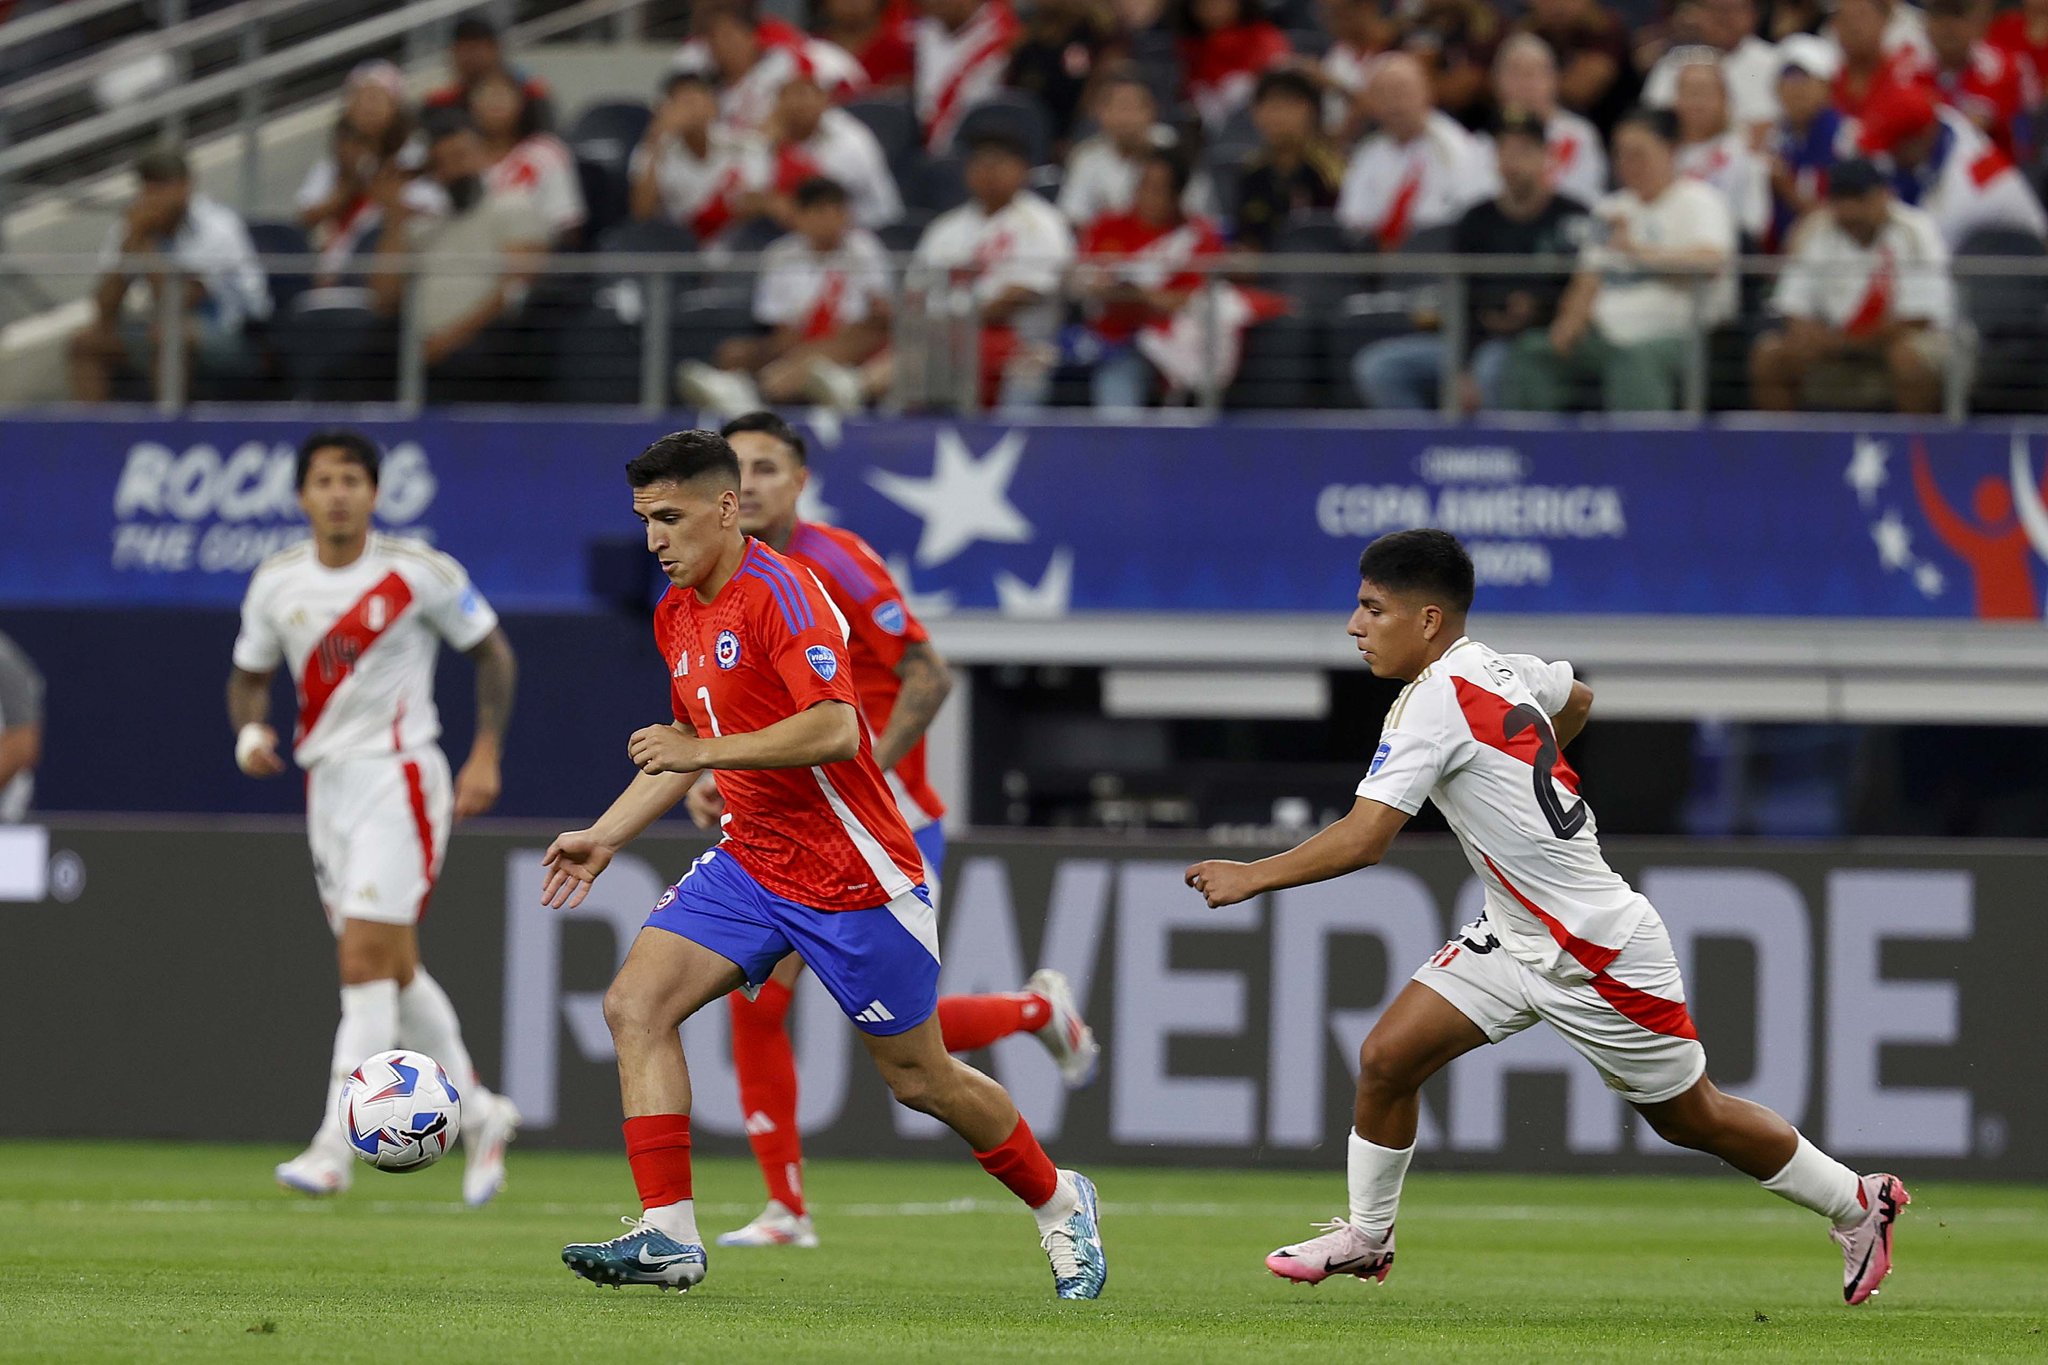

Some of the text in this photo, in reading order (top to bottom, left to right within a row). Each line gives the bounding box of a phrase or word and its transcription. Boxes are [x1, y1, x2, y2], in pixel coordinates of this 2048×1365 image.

[113, 441, 436, 523] ROCKG
[1316, 484, 1432, 536] COPA
[319, 635, 357, 682] 14
